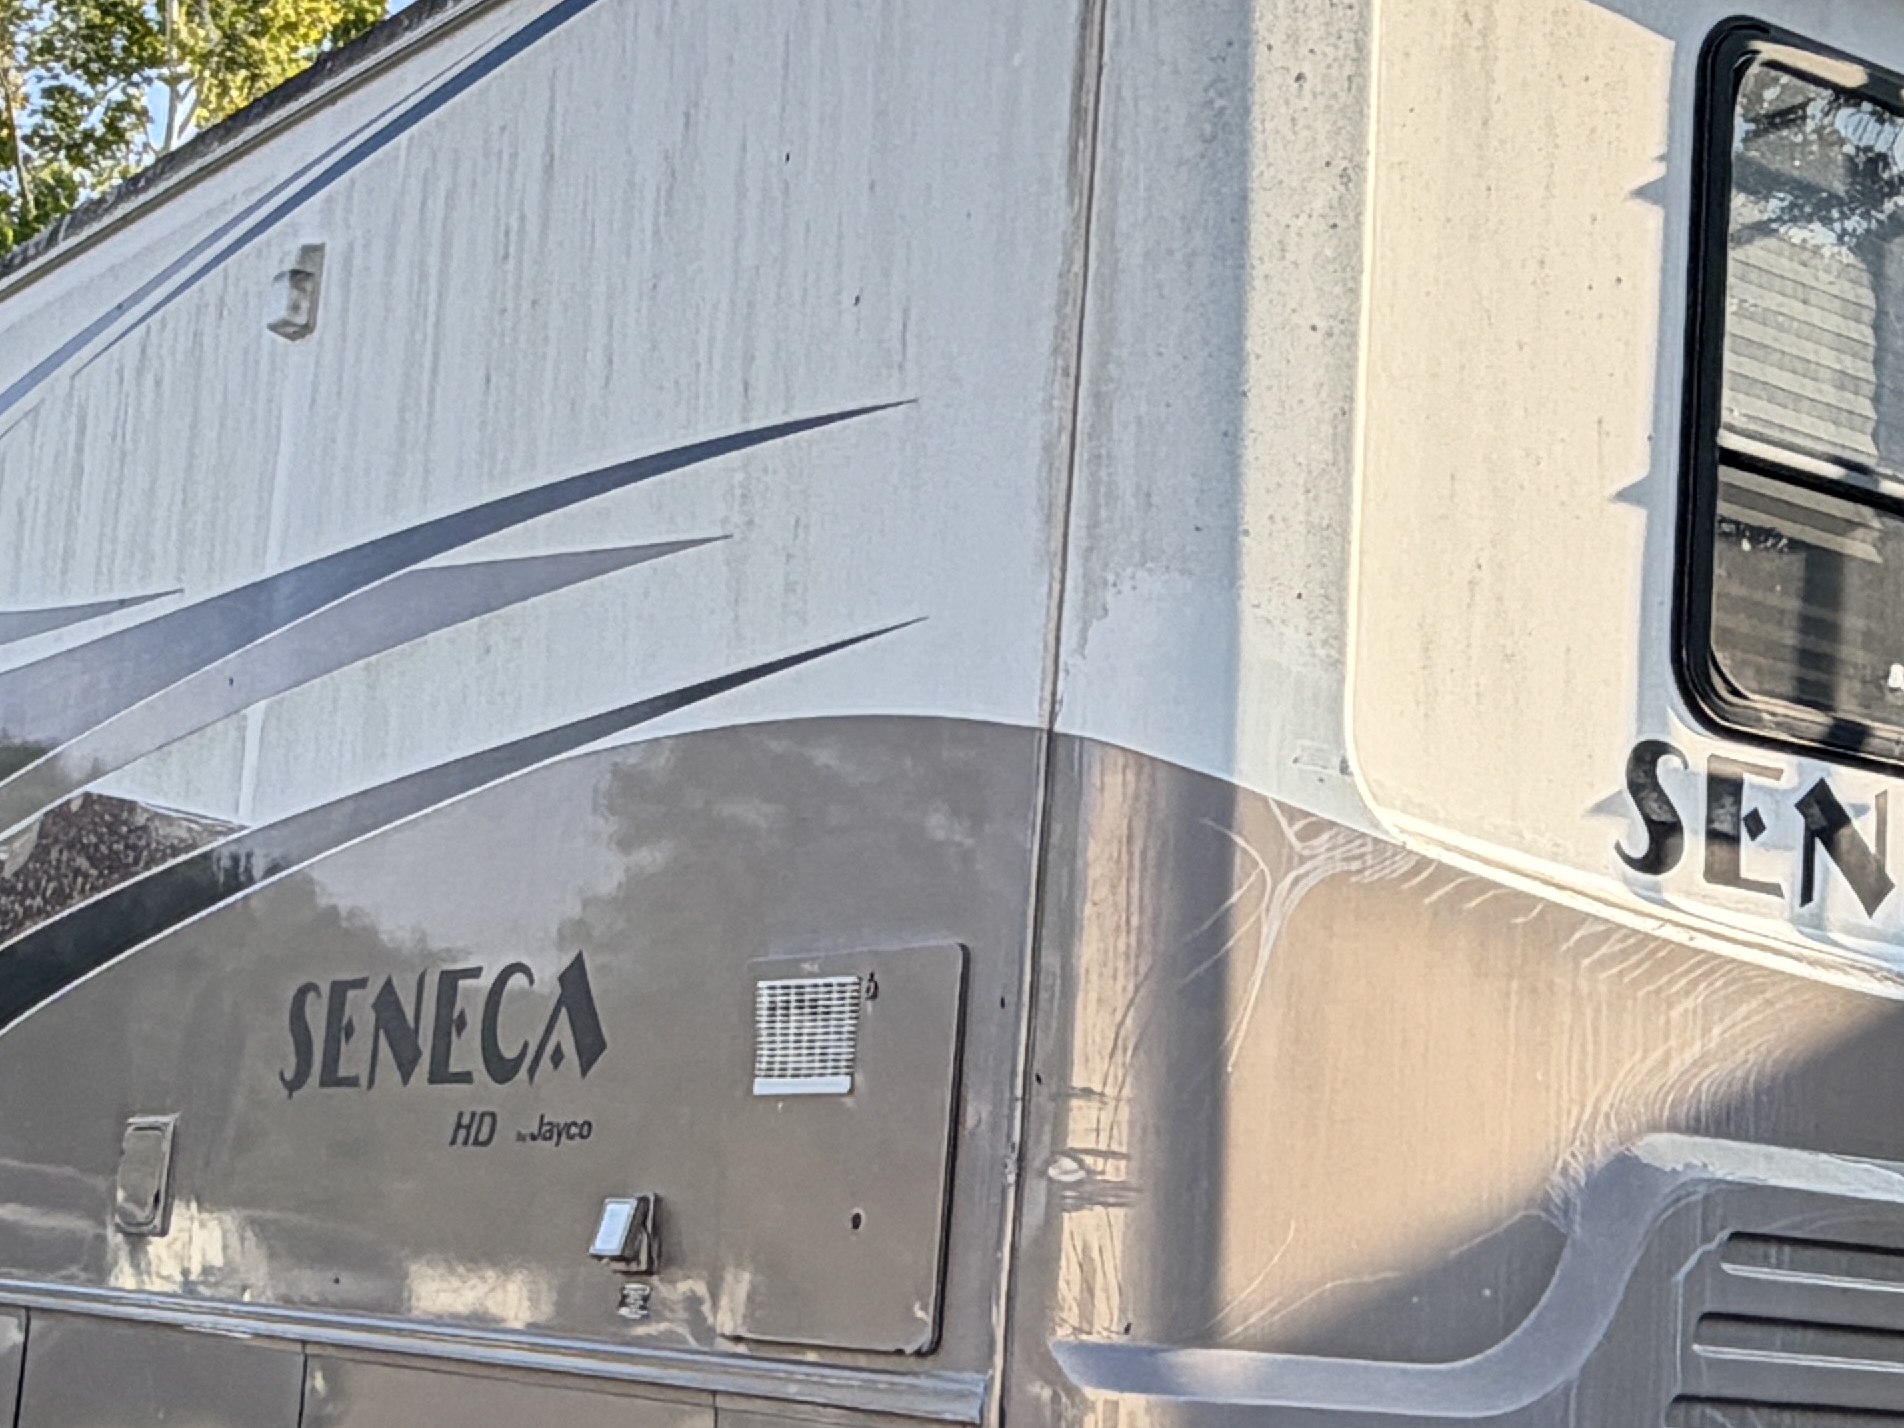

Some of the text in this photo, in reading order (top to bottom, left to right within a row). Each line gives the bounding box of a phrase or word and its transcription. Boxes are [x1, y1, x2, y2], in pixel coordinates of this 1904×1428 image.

[278, 949, 608, 1100] SENECA
[449, 1110, 497, 1148] HD
[529, 1113, 593, 1148] Jayco
